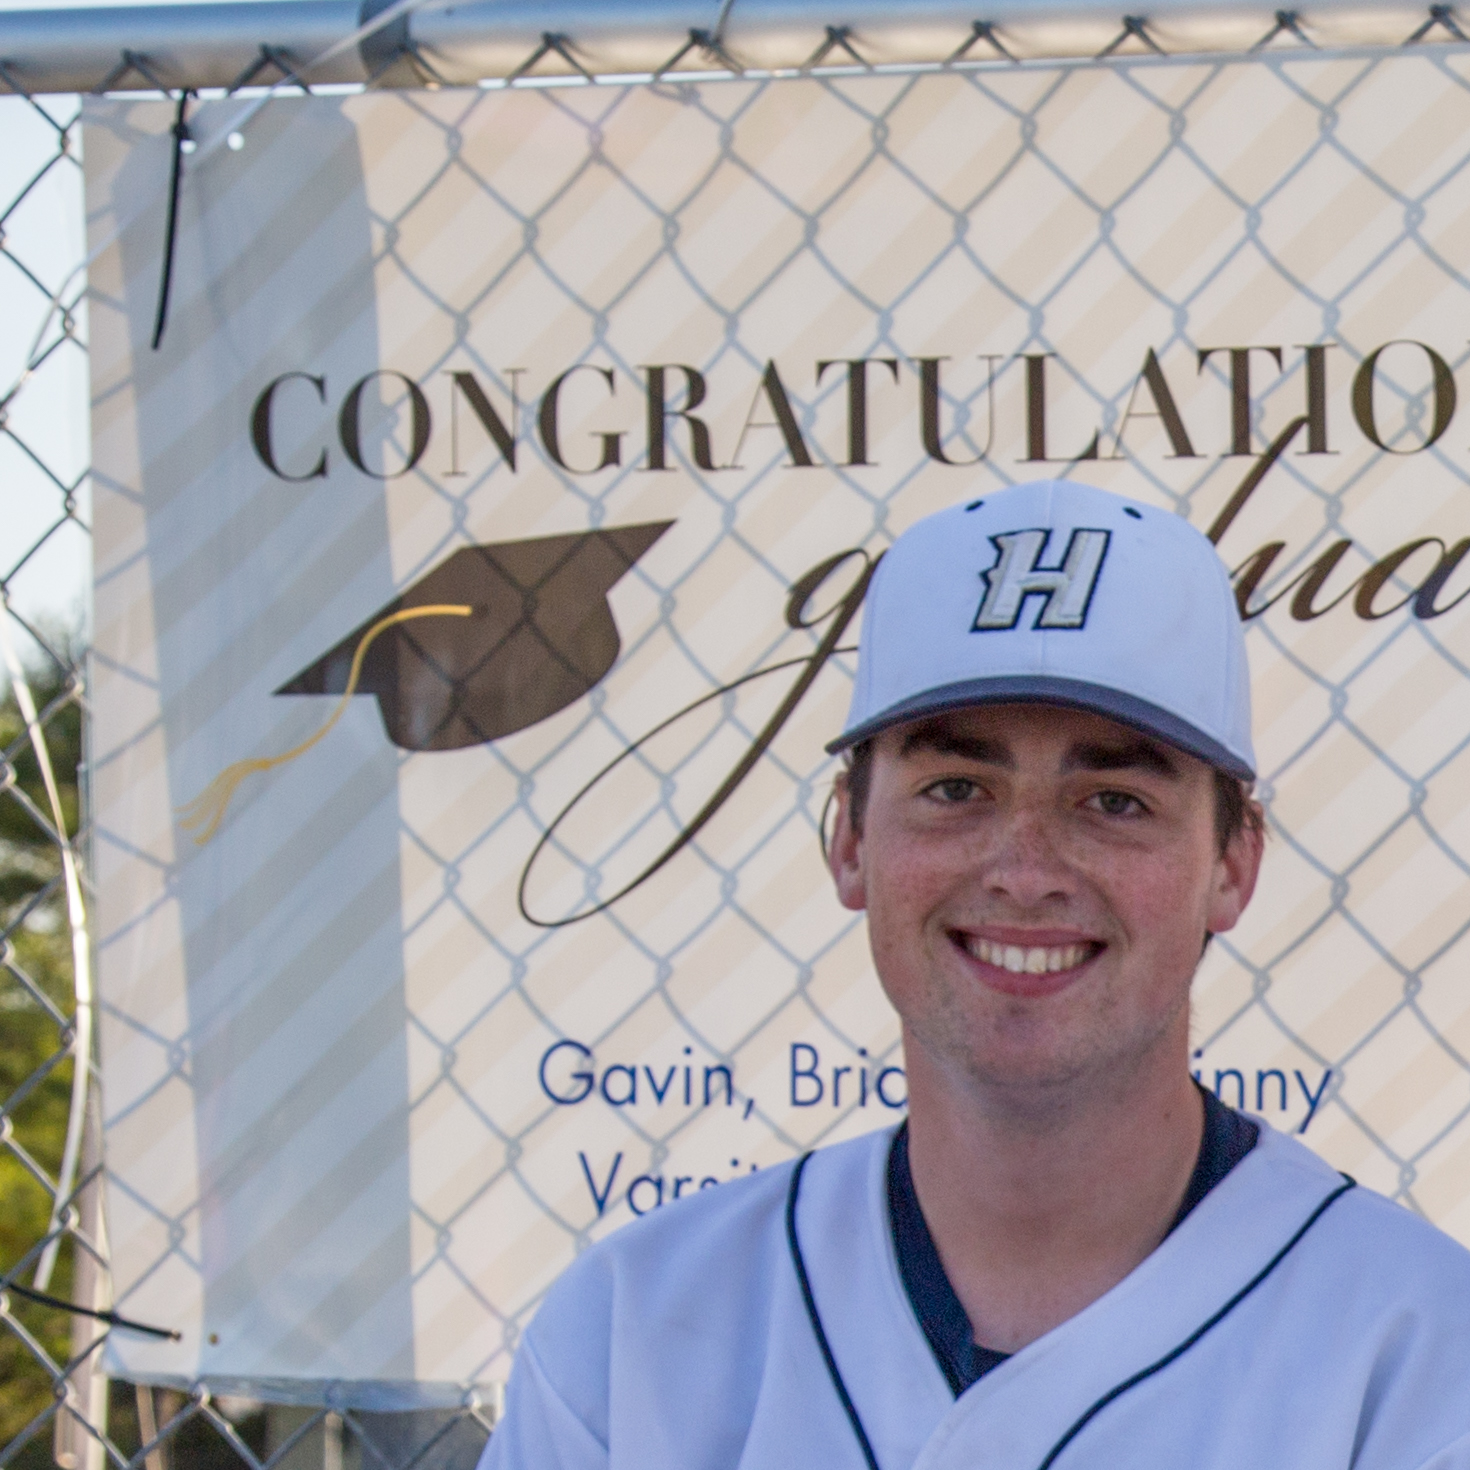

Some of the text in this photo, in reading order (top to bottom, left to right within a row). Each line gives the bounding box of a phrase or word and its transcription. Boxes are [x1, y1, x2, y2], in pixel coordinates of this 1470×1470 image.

[971, 527, 1112, 633] H
[538, 1039, 1334, 1135] Gavin, Bria inny
